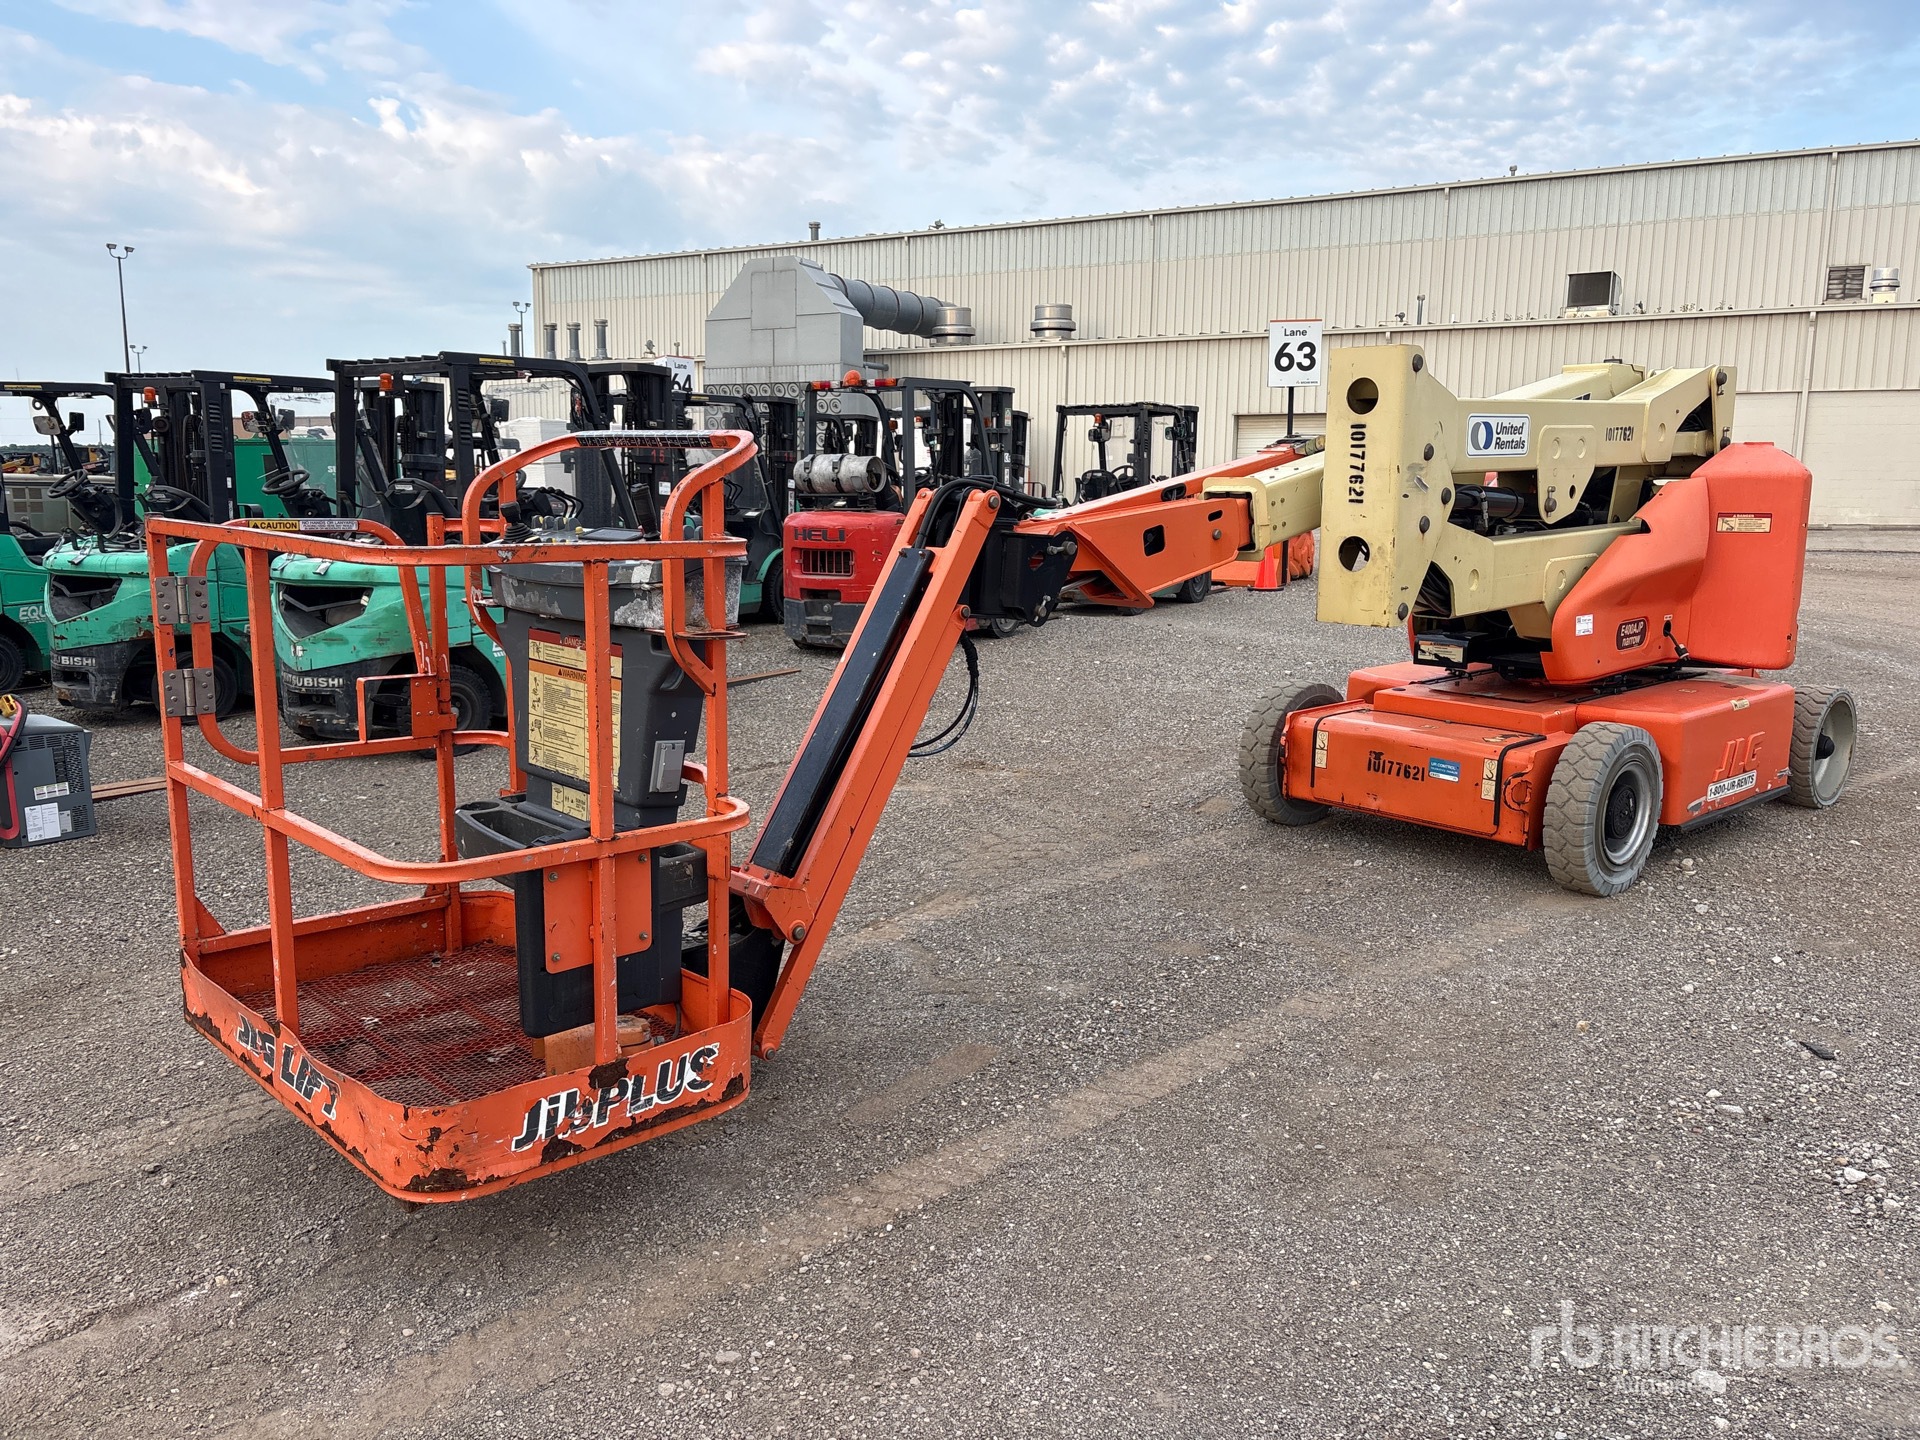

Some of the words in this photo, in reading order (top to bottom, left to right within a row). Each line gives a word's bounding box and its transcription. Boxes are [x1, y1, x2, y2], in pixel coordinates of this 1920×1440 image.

[1284, 328, 1307, 336] Lane
[1274, 341, 1316, 372] 63
[674, 362, 688, 370] Lane
[671, 373, 693, 393] 64
[1495, 422, 1524, 436] United
[1605, 426, 1634, 442] 10177621
[1494, 437, 1526, 450] Rentals
[1348, 423, 1367, 504] 10177621
[794, 528, 845, 542] HELI
[562, 667, 586, 682] WARNING
[1709, 774, 1755, 797] 1-800-UR-RENTS
[280, 1043, 342, 1119] LIFT
